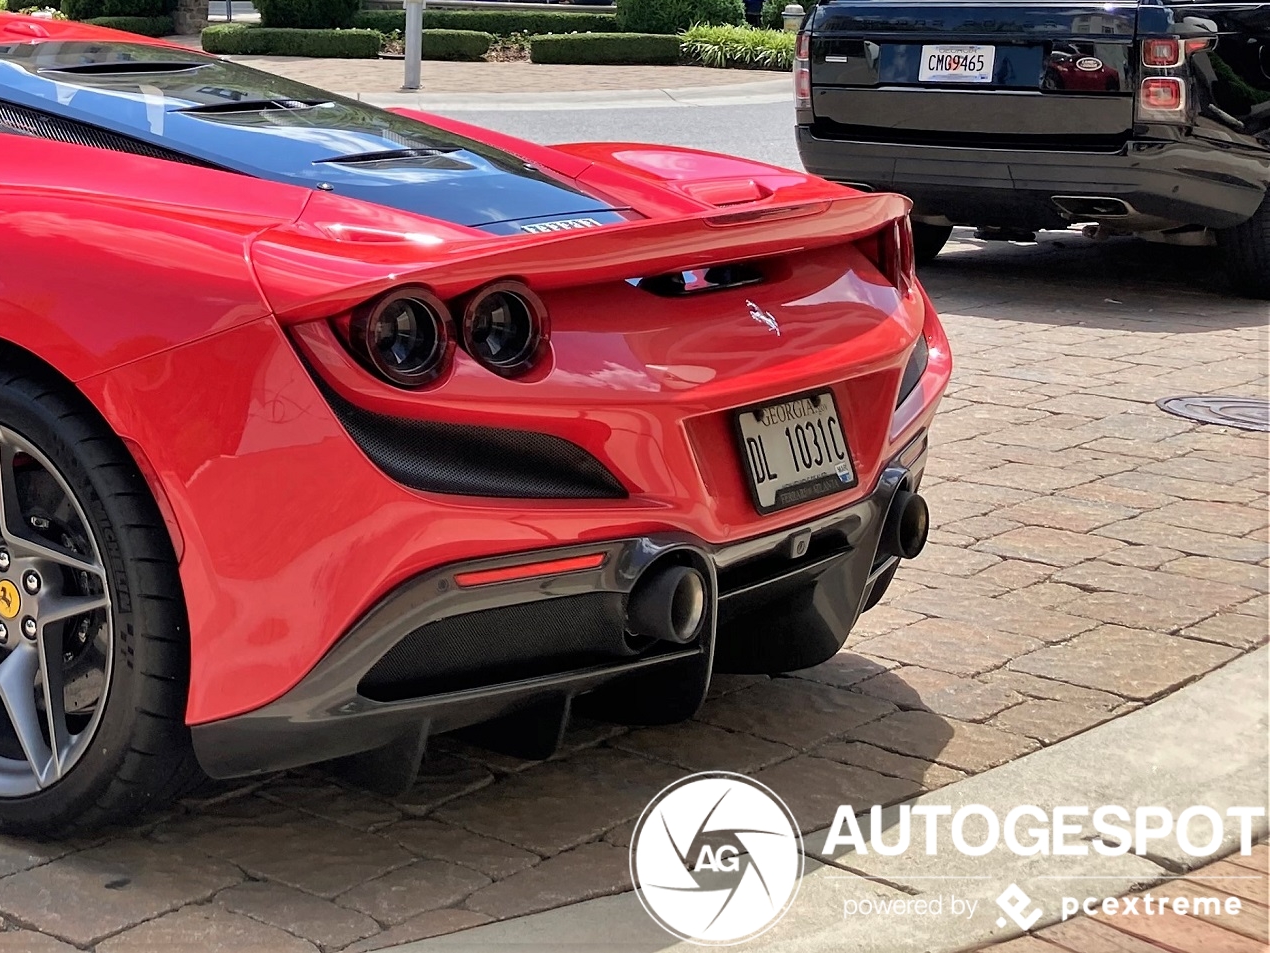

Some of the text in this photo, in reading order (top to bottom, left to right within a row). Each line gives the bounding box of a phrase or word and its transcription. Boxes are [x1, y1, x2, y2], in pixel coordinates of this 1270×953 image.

[928, 55, 984, 71] CMG9465
[746, 416, 845, 484] DL 1031C
